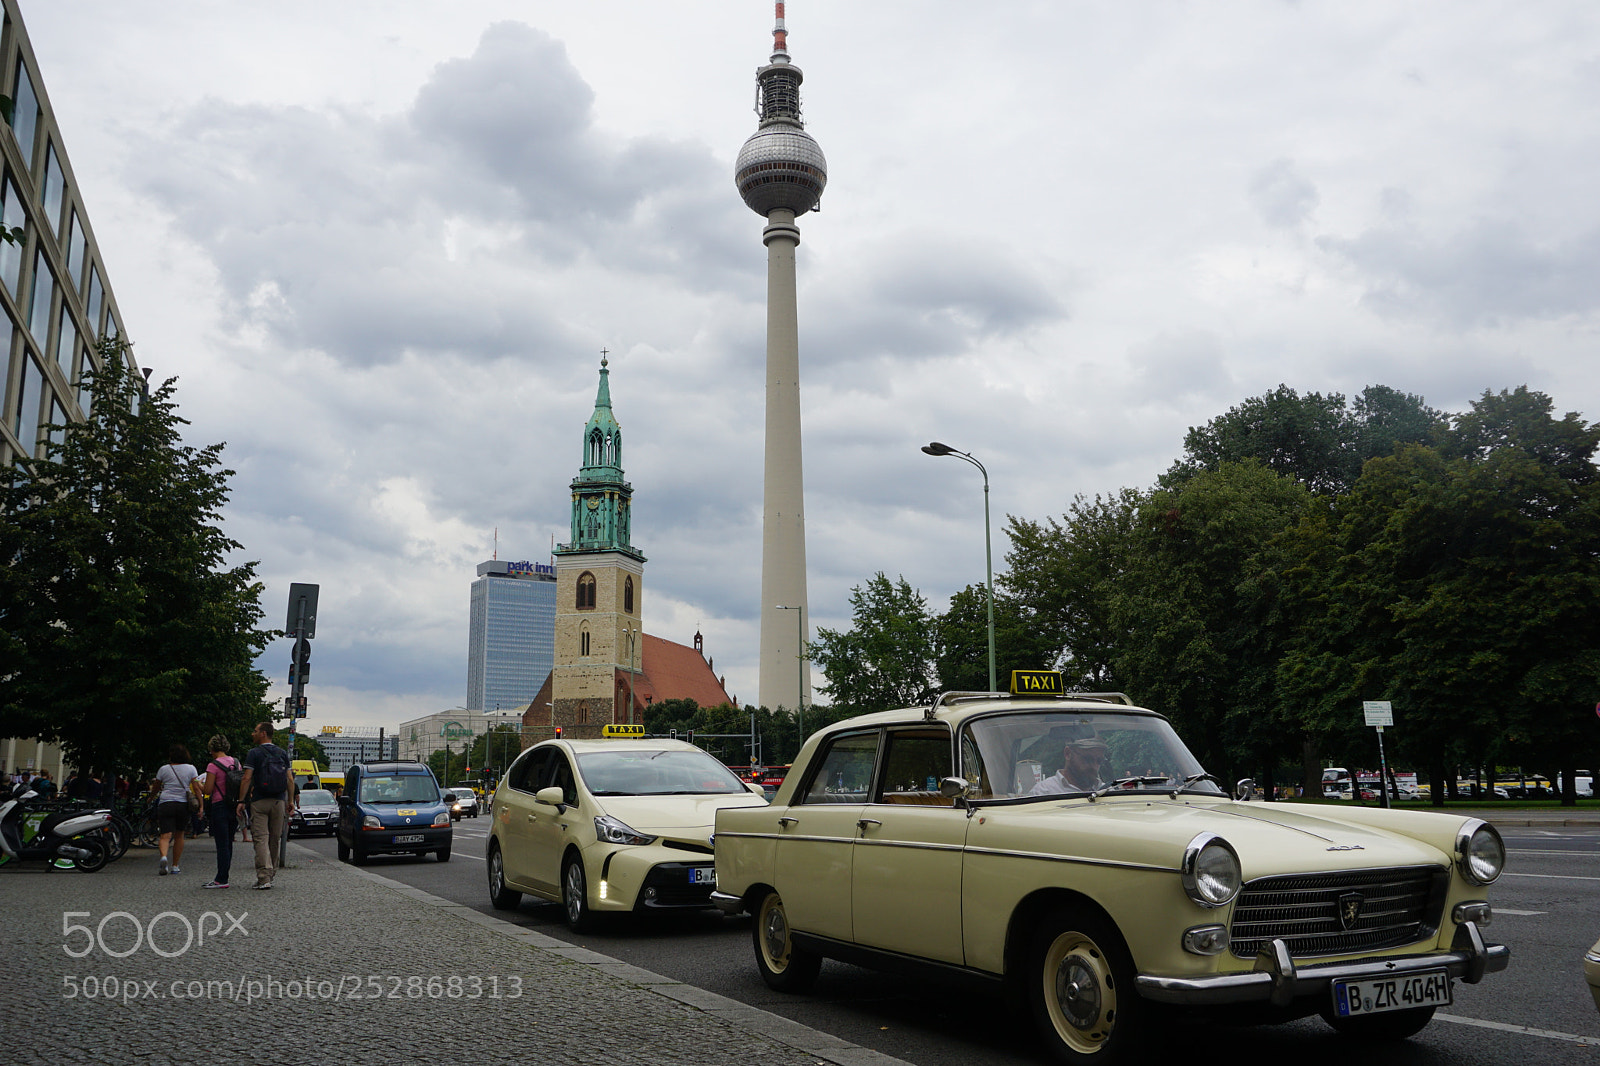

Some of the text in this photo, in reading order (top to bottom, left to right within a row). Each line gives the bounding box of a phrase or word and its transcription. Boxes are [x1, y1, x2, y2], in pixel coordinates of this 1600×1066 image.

[508, 561, 553, 574] park inn
[1021, 675, 1055, 690] TAXI
[322, 725, 343, 734] ADAC
[695, 869, 703, 881] B
[1348, 985, 1362, 1012] B
[1373, 981, 1399, 1009] ZR
[1402, 975, 1448, 1005] 404H
